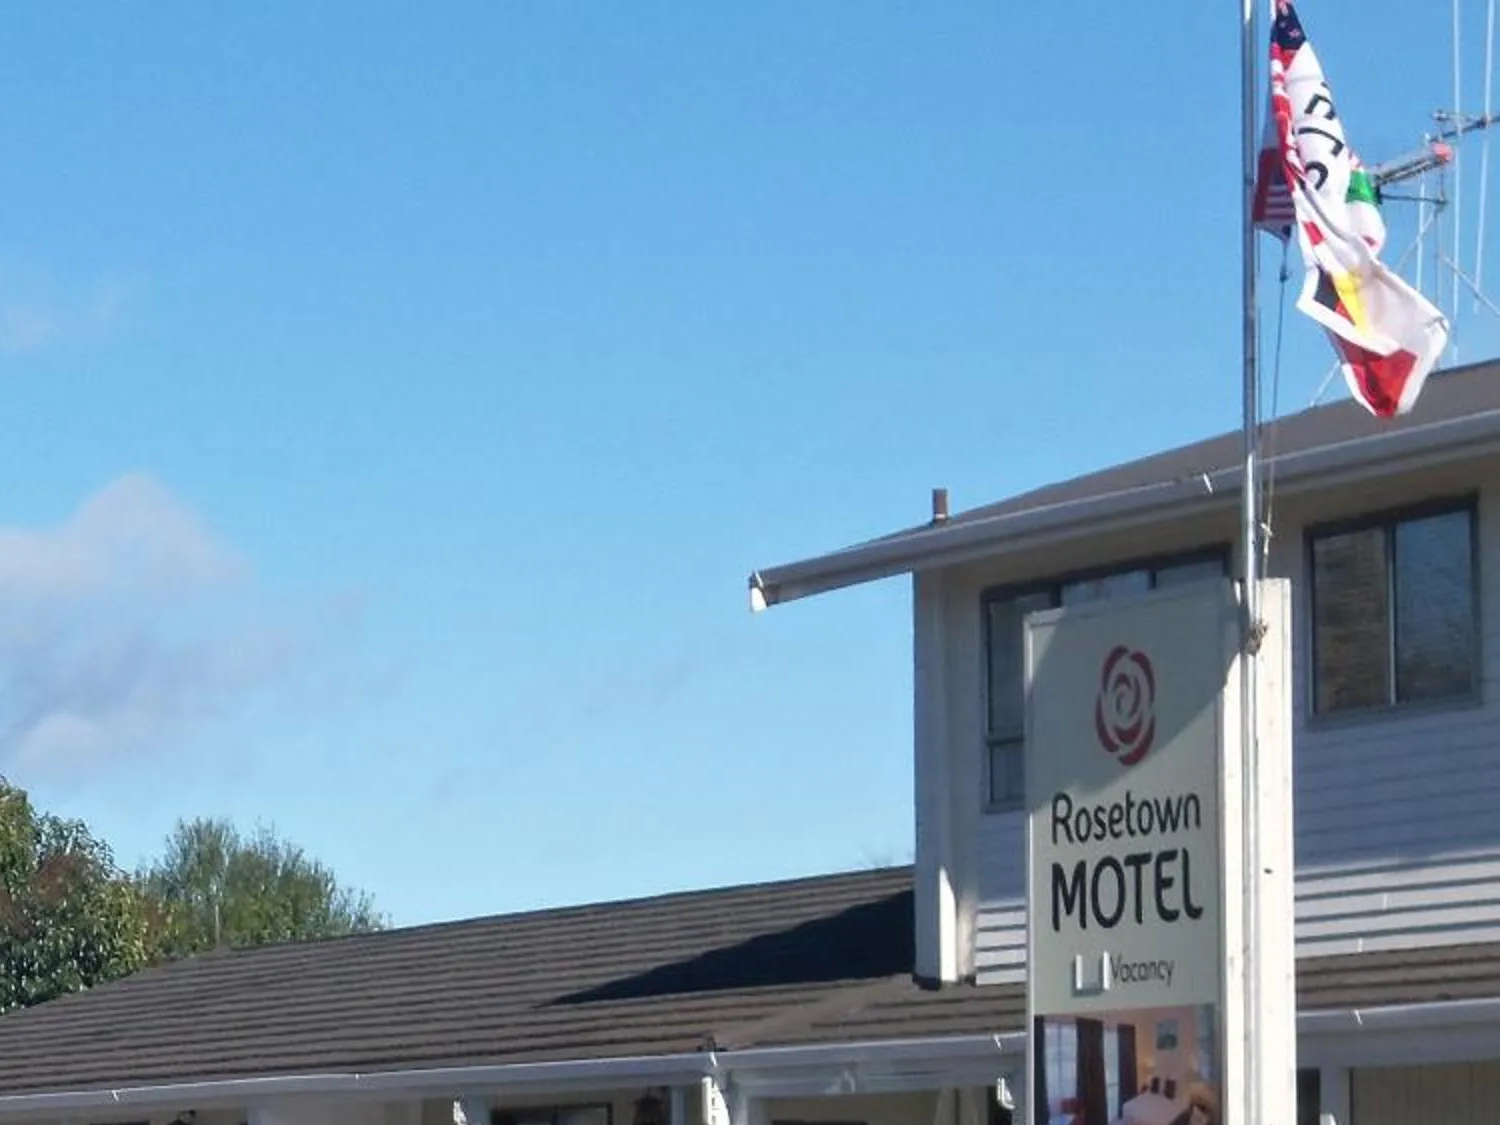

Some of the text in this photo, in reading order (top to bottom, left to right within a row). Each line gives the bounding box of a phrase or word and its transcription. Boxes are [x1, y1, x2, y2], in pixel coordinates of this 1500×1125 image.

[1052, 790, 1200, 845] Rosetown
[1052, 848, 1203, 931] MOTEL
[1110, 953, 1175, 987] Vacancy
